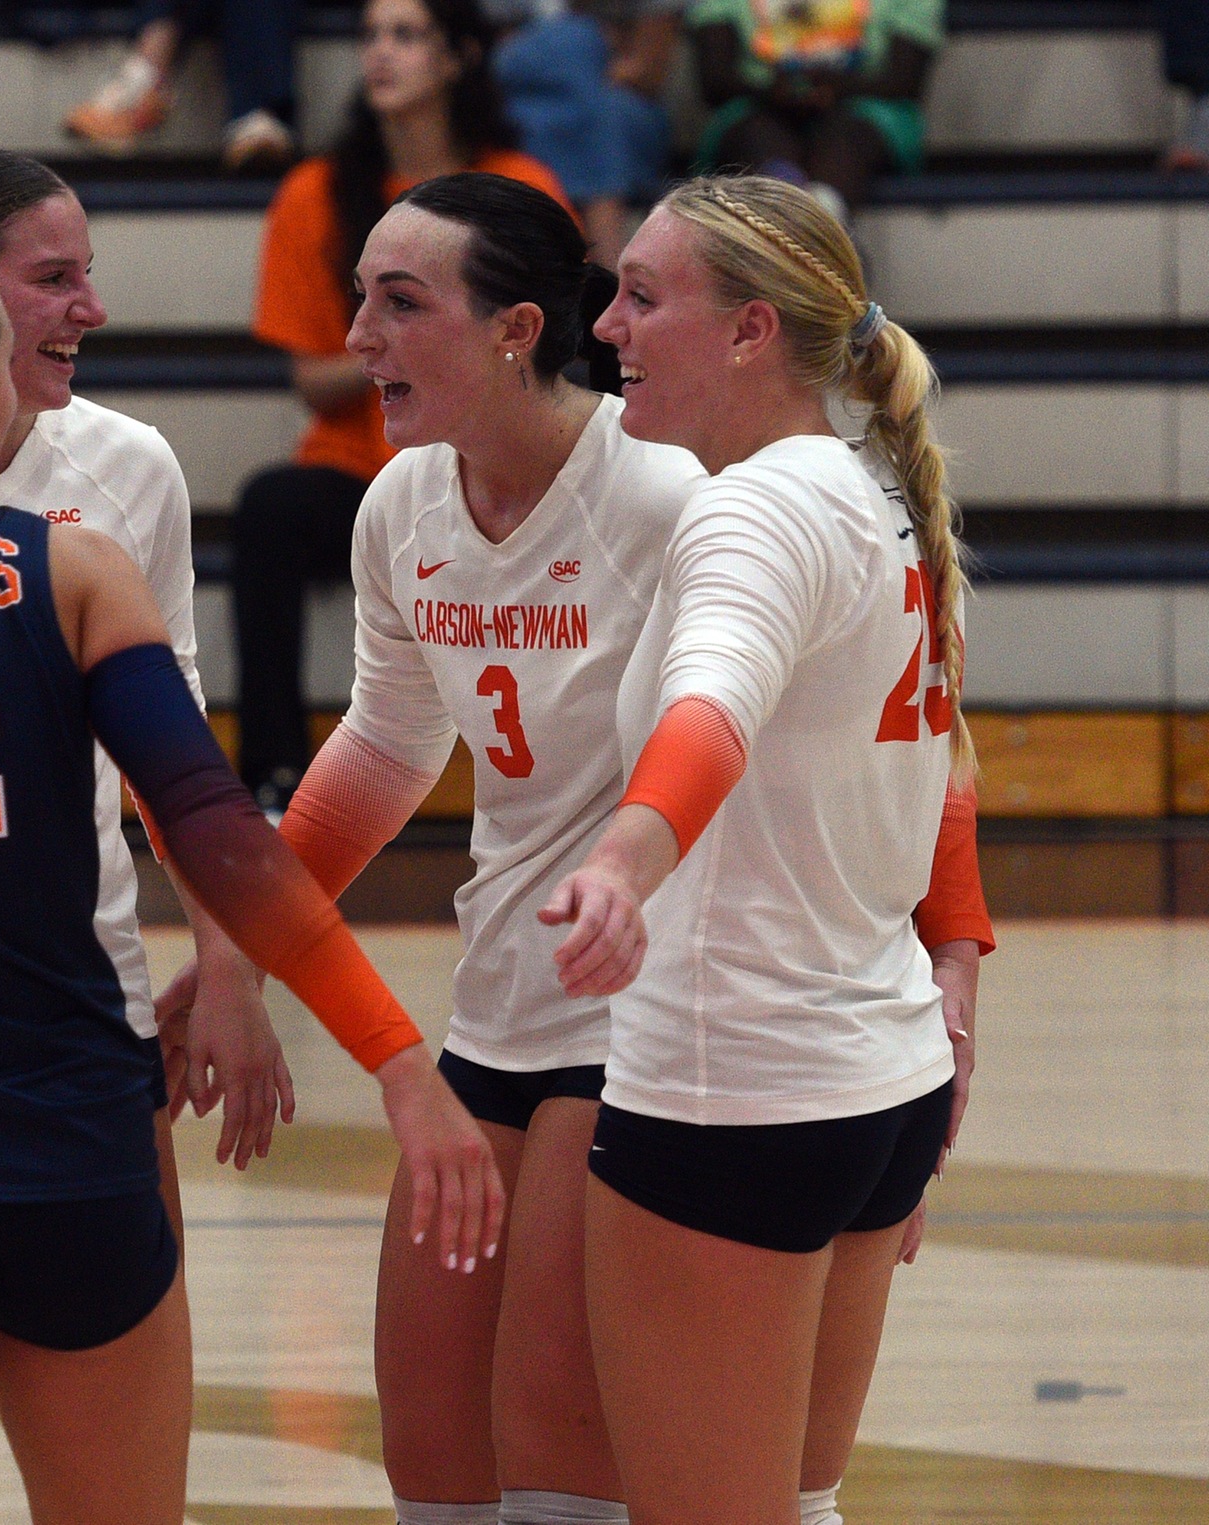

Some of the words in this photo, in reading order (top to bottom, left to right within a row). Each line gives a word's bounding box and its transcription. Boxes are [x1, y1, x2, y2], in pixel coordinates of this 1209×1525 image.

[45, 508, 82, 525] SAC
[552, 560, 582, 577] SAC
[413, 597, 589, 651] CARSON-NEWMAN
[476, 664, 536, 779] 3
